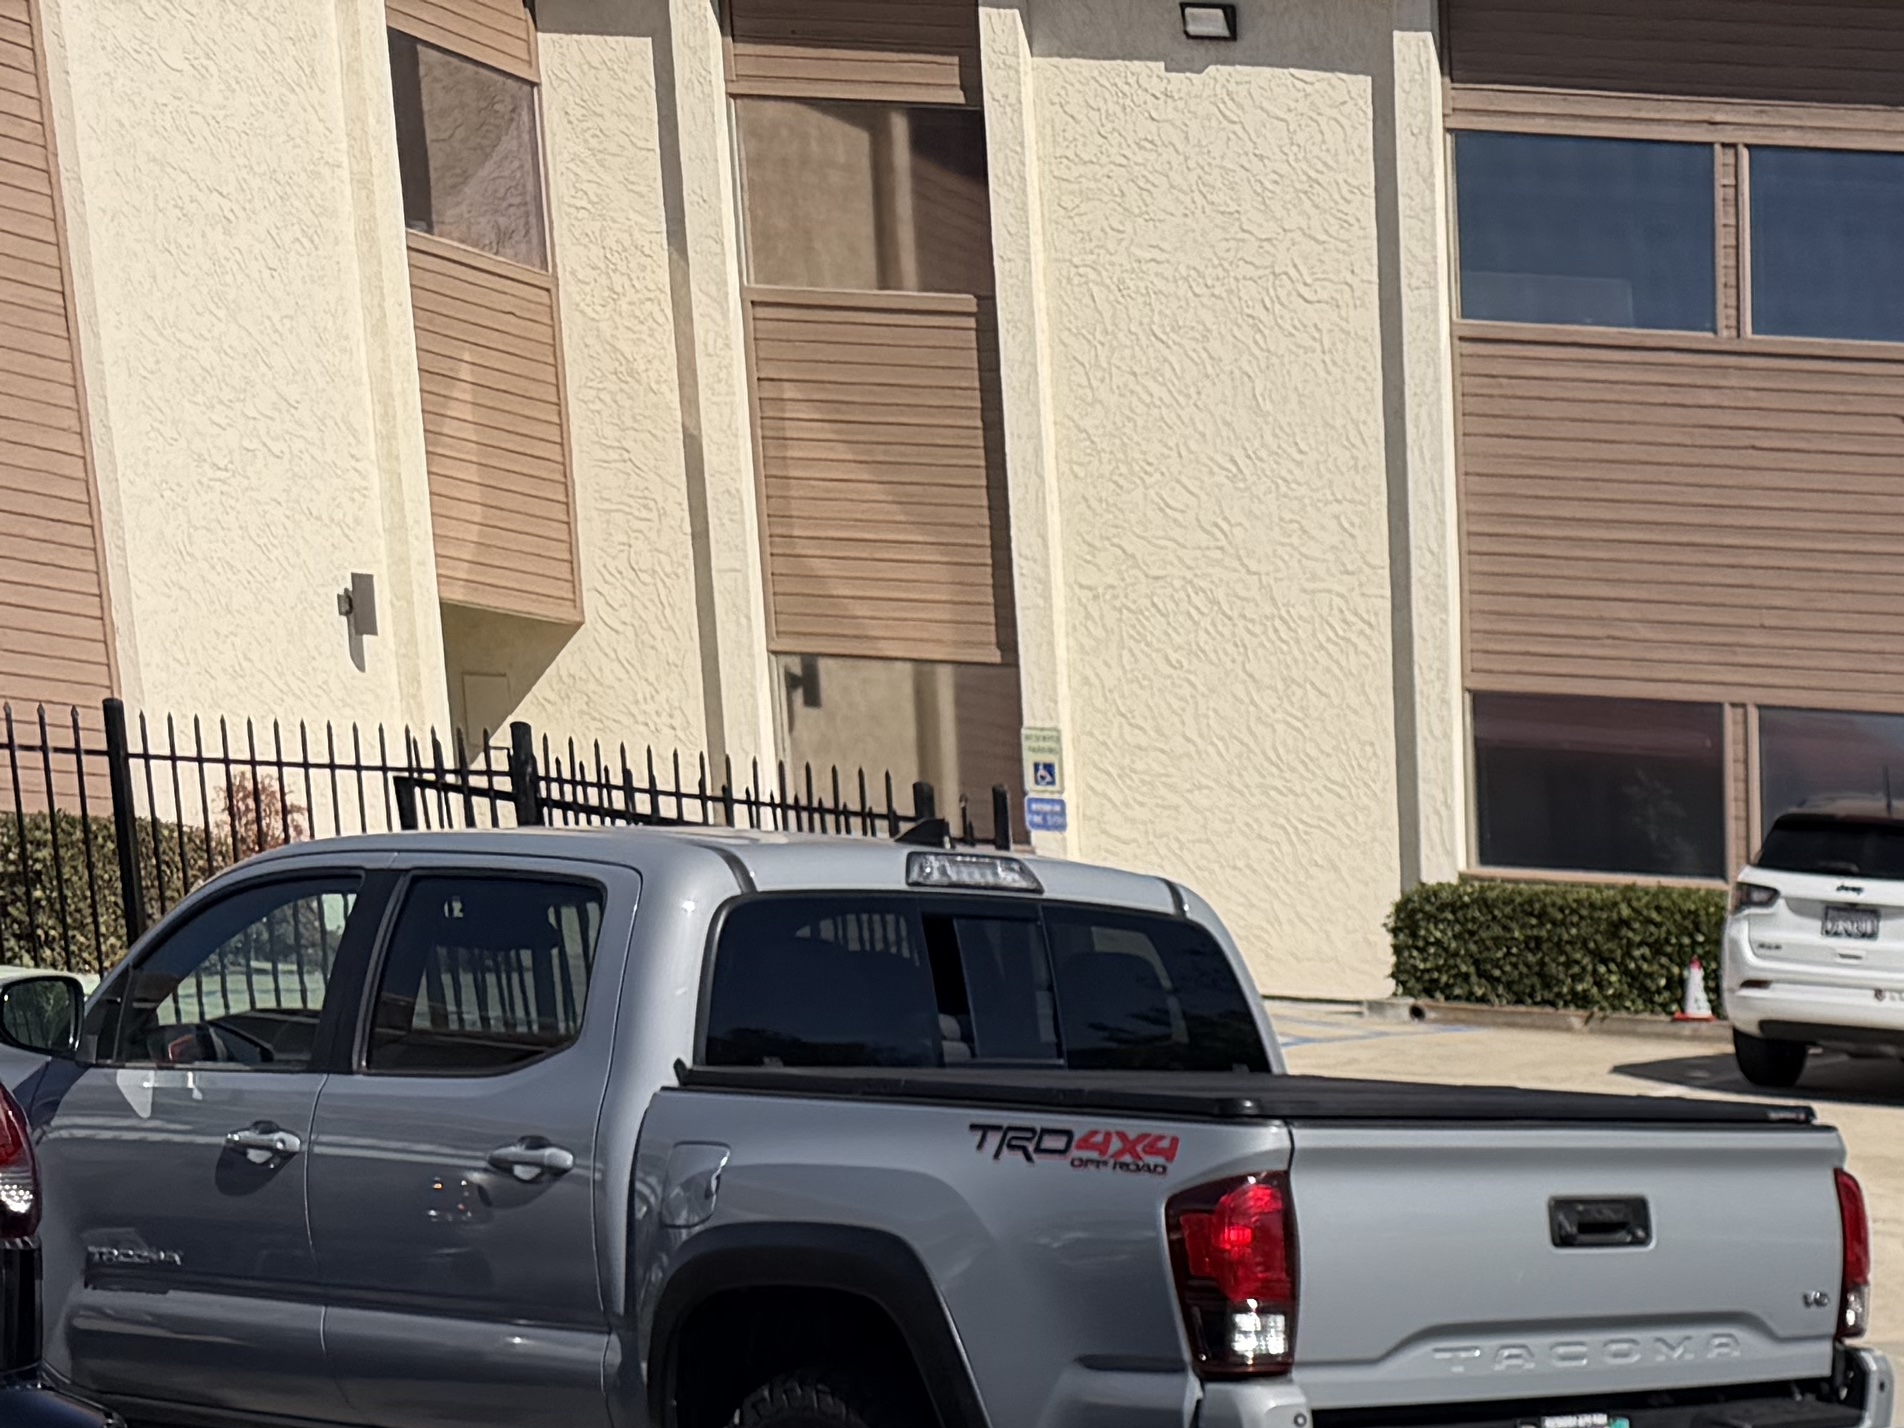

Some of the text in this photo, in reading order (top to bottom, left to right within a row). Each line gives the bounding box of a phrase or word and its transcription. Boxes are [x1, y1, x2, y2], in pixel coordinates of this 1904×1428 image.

[969, 1122, 1075, 1164] TRD
[1070, 1158, 1168, 1176] OFF ROAD
[1802, 1291, 1829, 1309] V6
[1431, 1332, 1741, 1373] TACOMA
